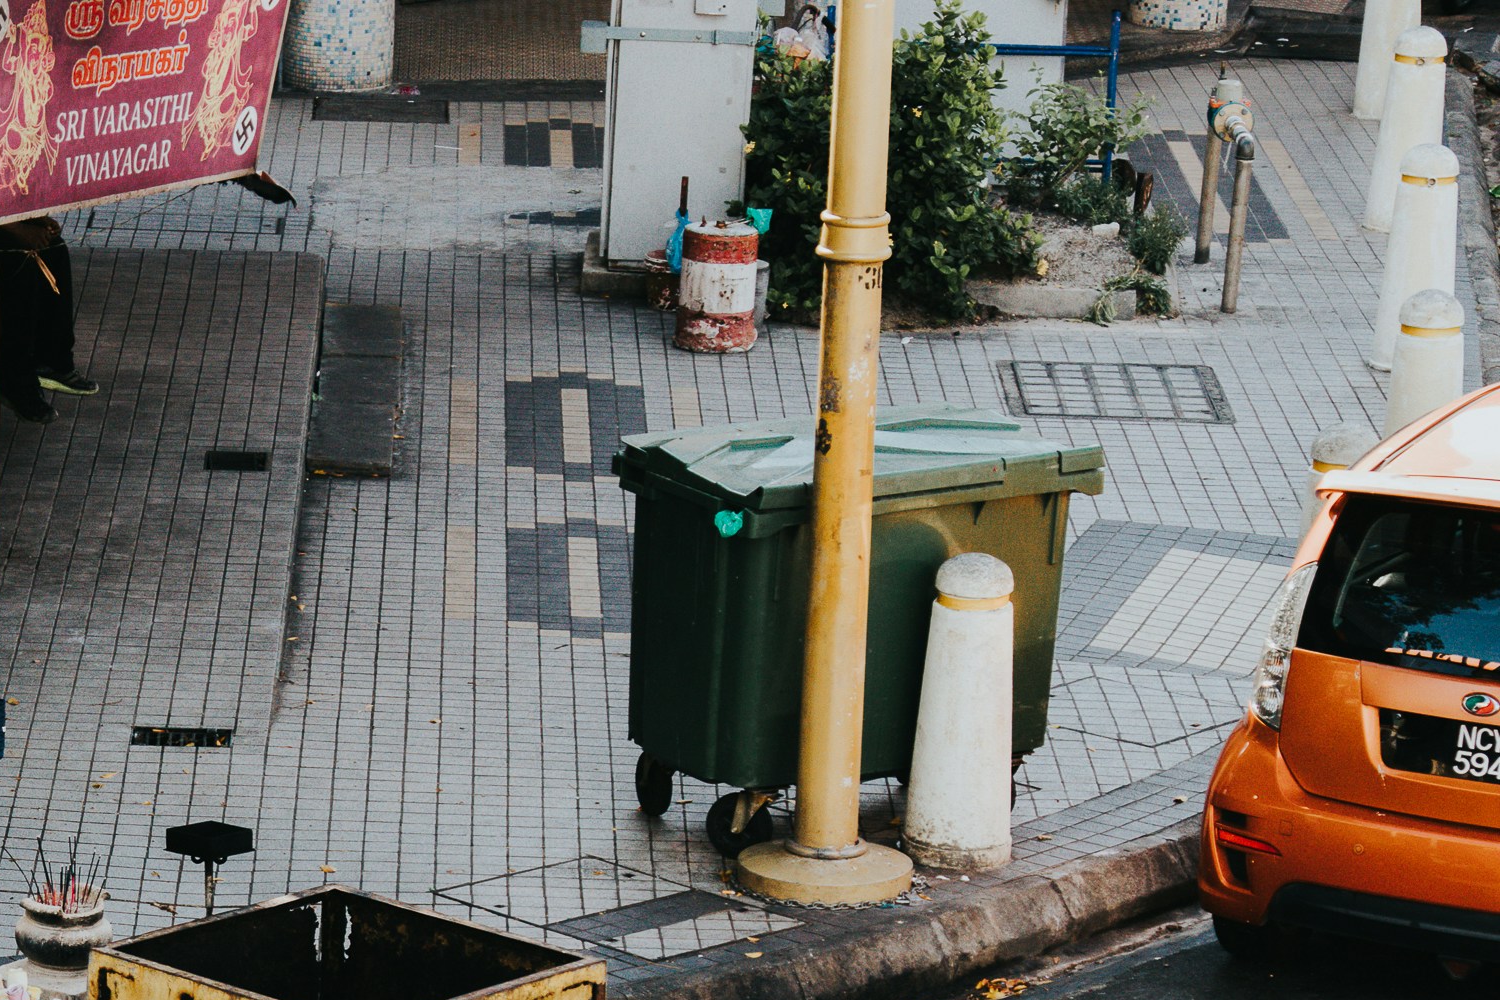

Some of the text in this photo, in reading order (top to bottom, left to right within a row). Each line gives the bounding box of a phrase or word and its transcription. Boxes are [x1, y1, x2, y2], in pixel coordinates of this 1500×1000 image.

[72, 29, 190, 97] விநாயகர்
[55, 92, 193, 143] SRI VARASITHI
[66, 139, 172, 186] VINAYAGAR
